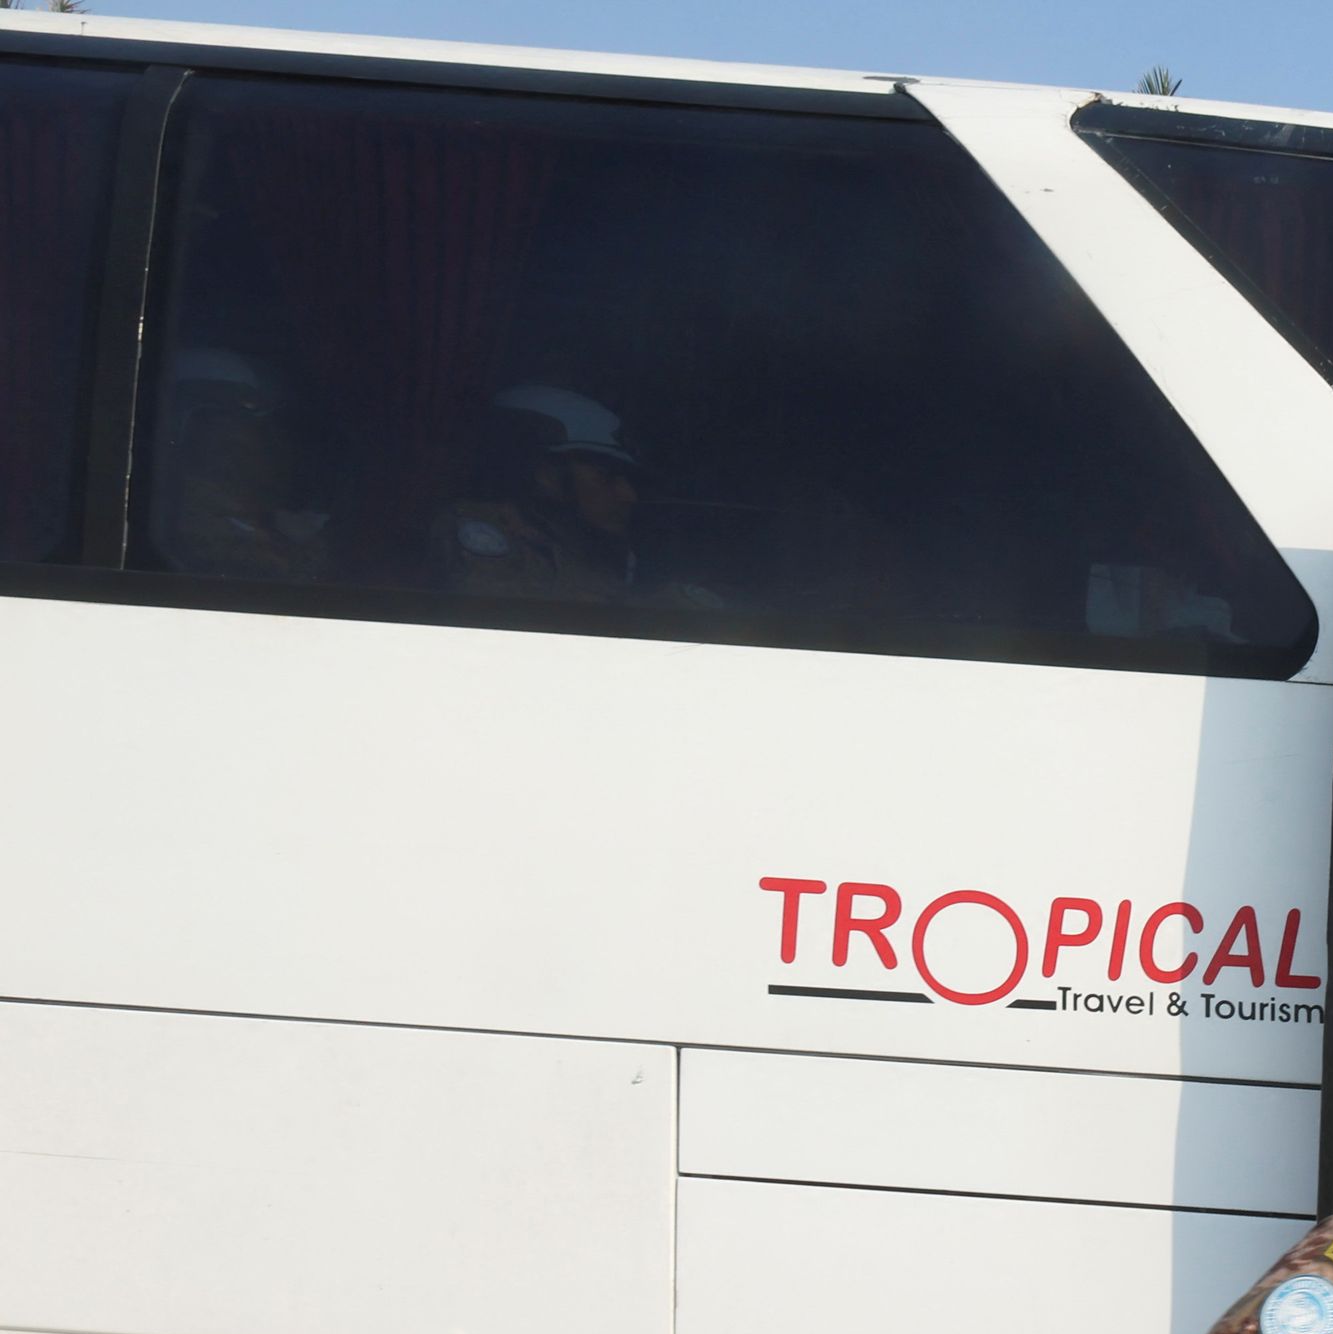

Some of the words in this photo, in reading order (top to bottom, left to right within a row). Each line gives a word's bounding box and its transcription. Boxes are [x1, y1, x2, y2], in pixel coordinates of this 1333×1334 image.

[759, 876, 1322, 1006] TROPICAL
[1057, 986, 1154, 1016] Travel
[1166, 991, 1189, 1017] &
[1200, 993, 1325, 1024] Tourism
